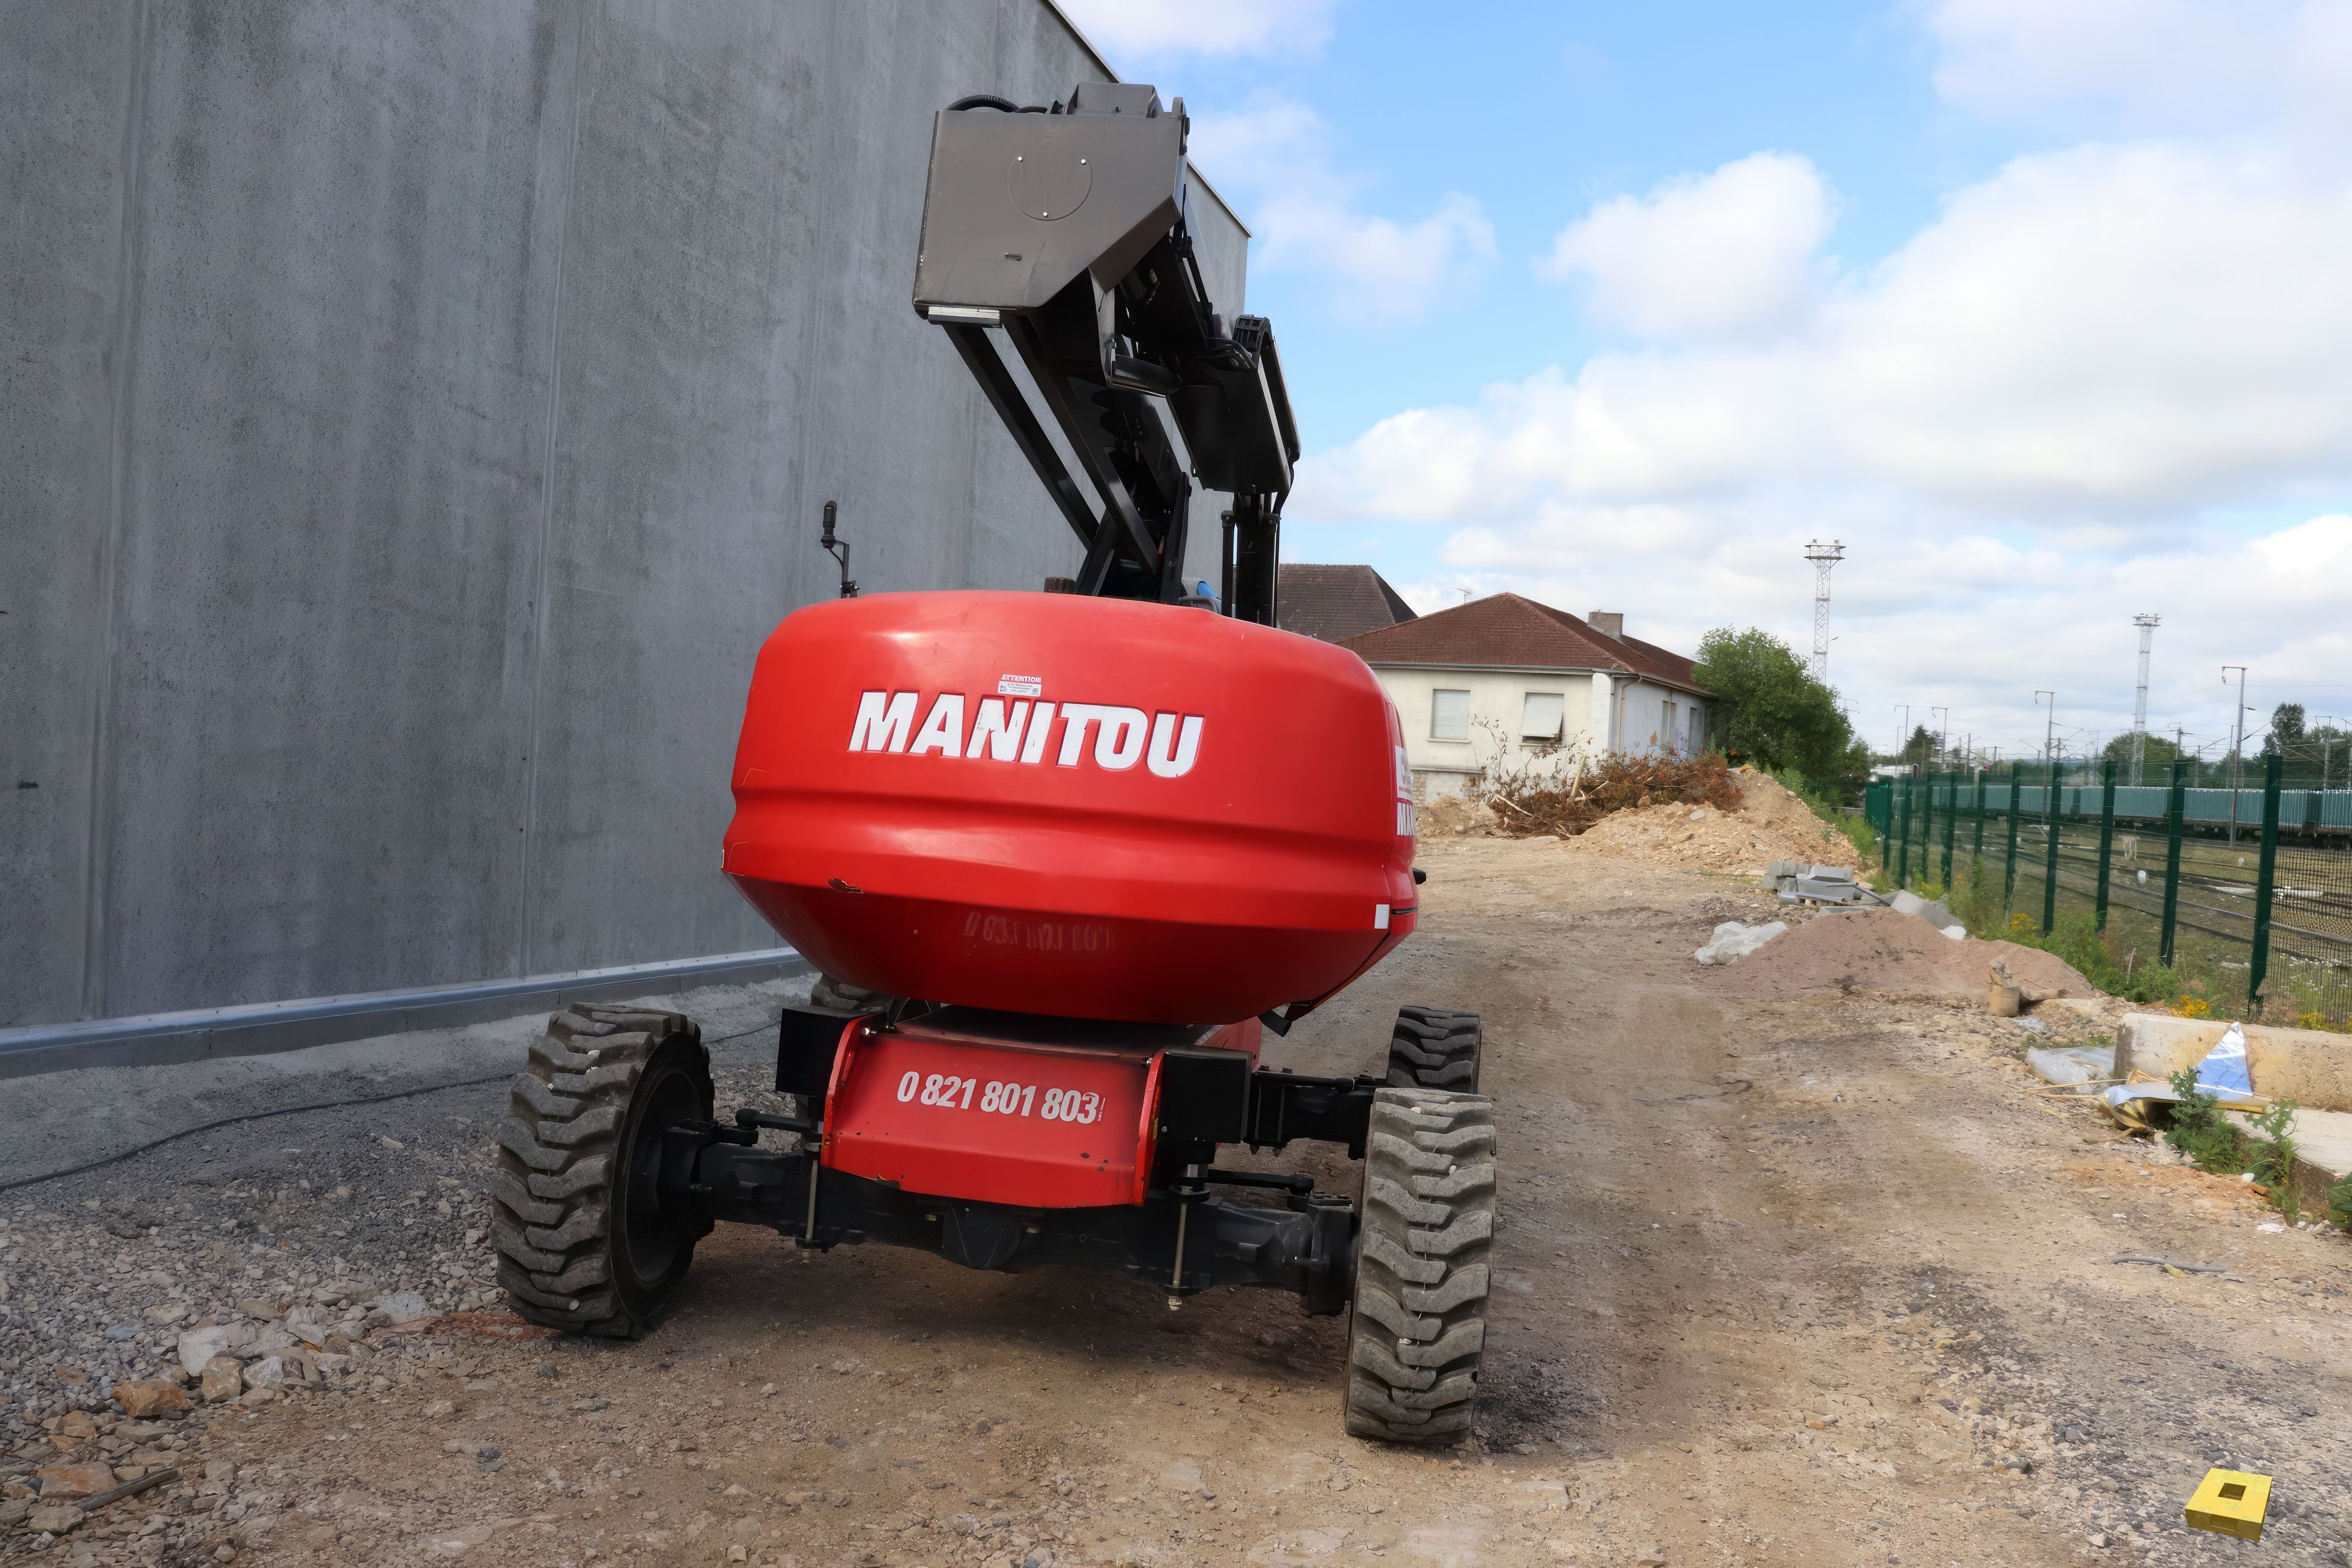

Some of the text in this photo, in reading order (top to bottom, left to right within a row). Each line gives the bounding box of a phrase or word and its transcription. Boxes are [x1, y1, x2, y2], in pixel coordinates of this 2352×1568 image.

[848, 691, 1204, 778] MANITOU
[897, 1071, 1100, 1124] 0 821 801 803
